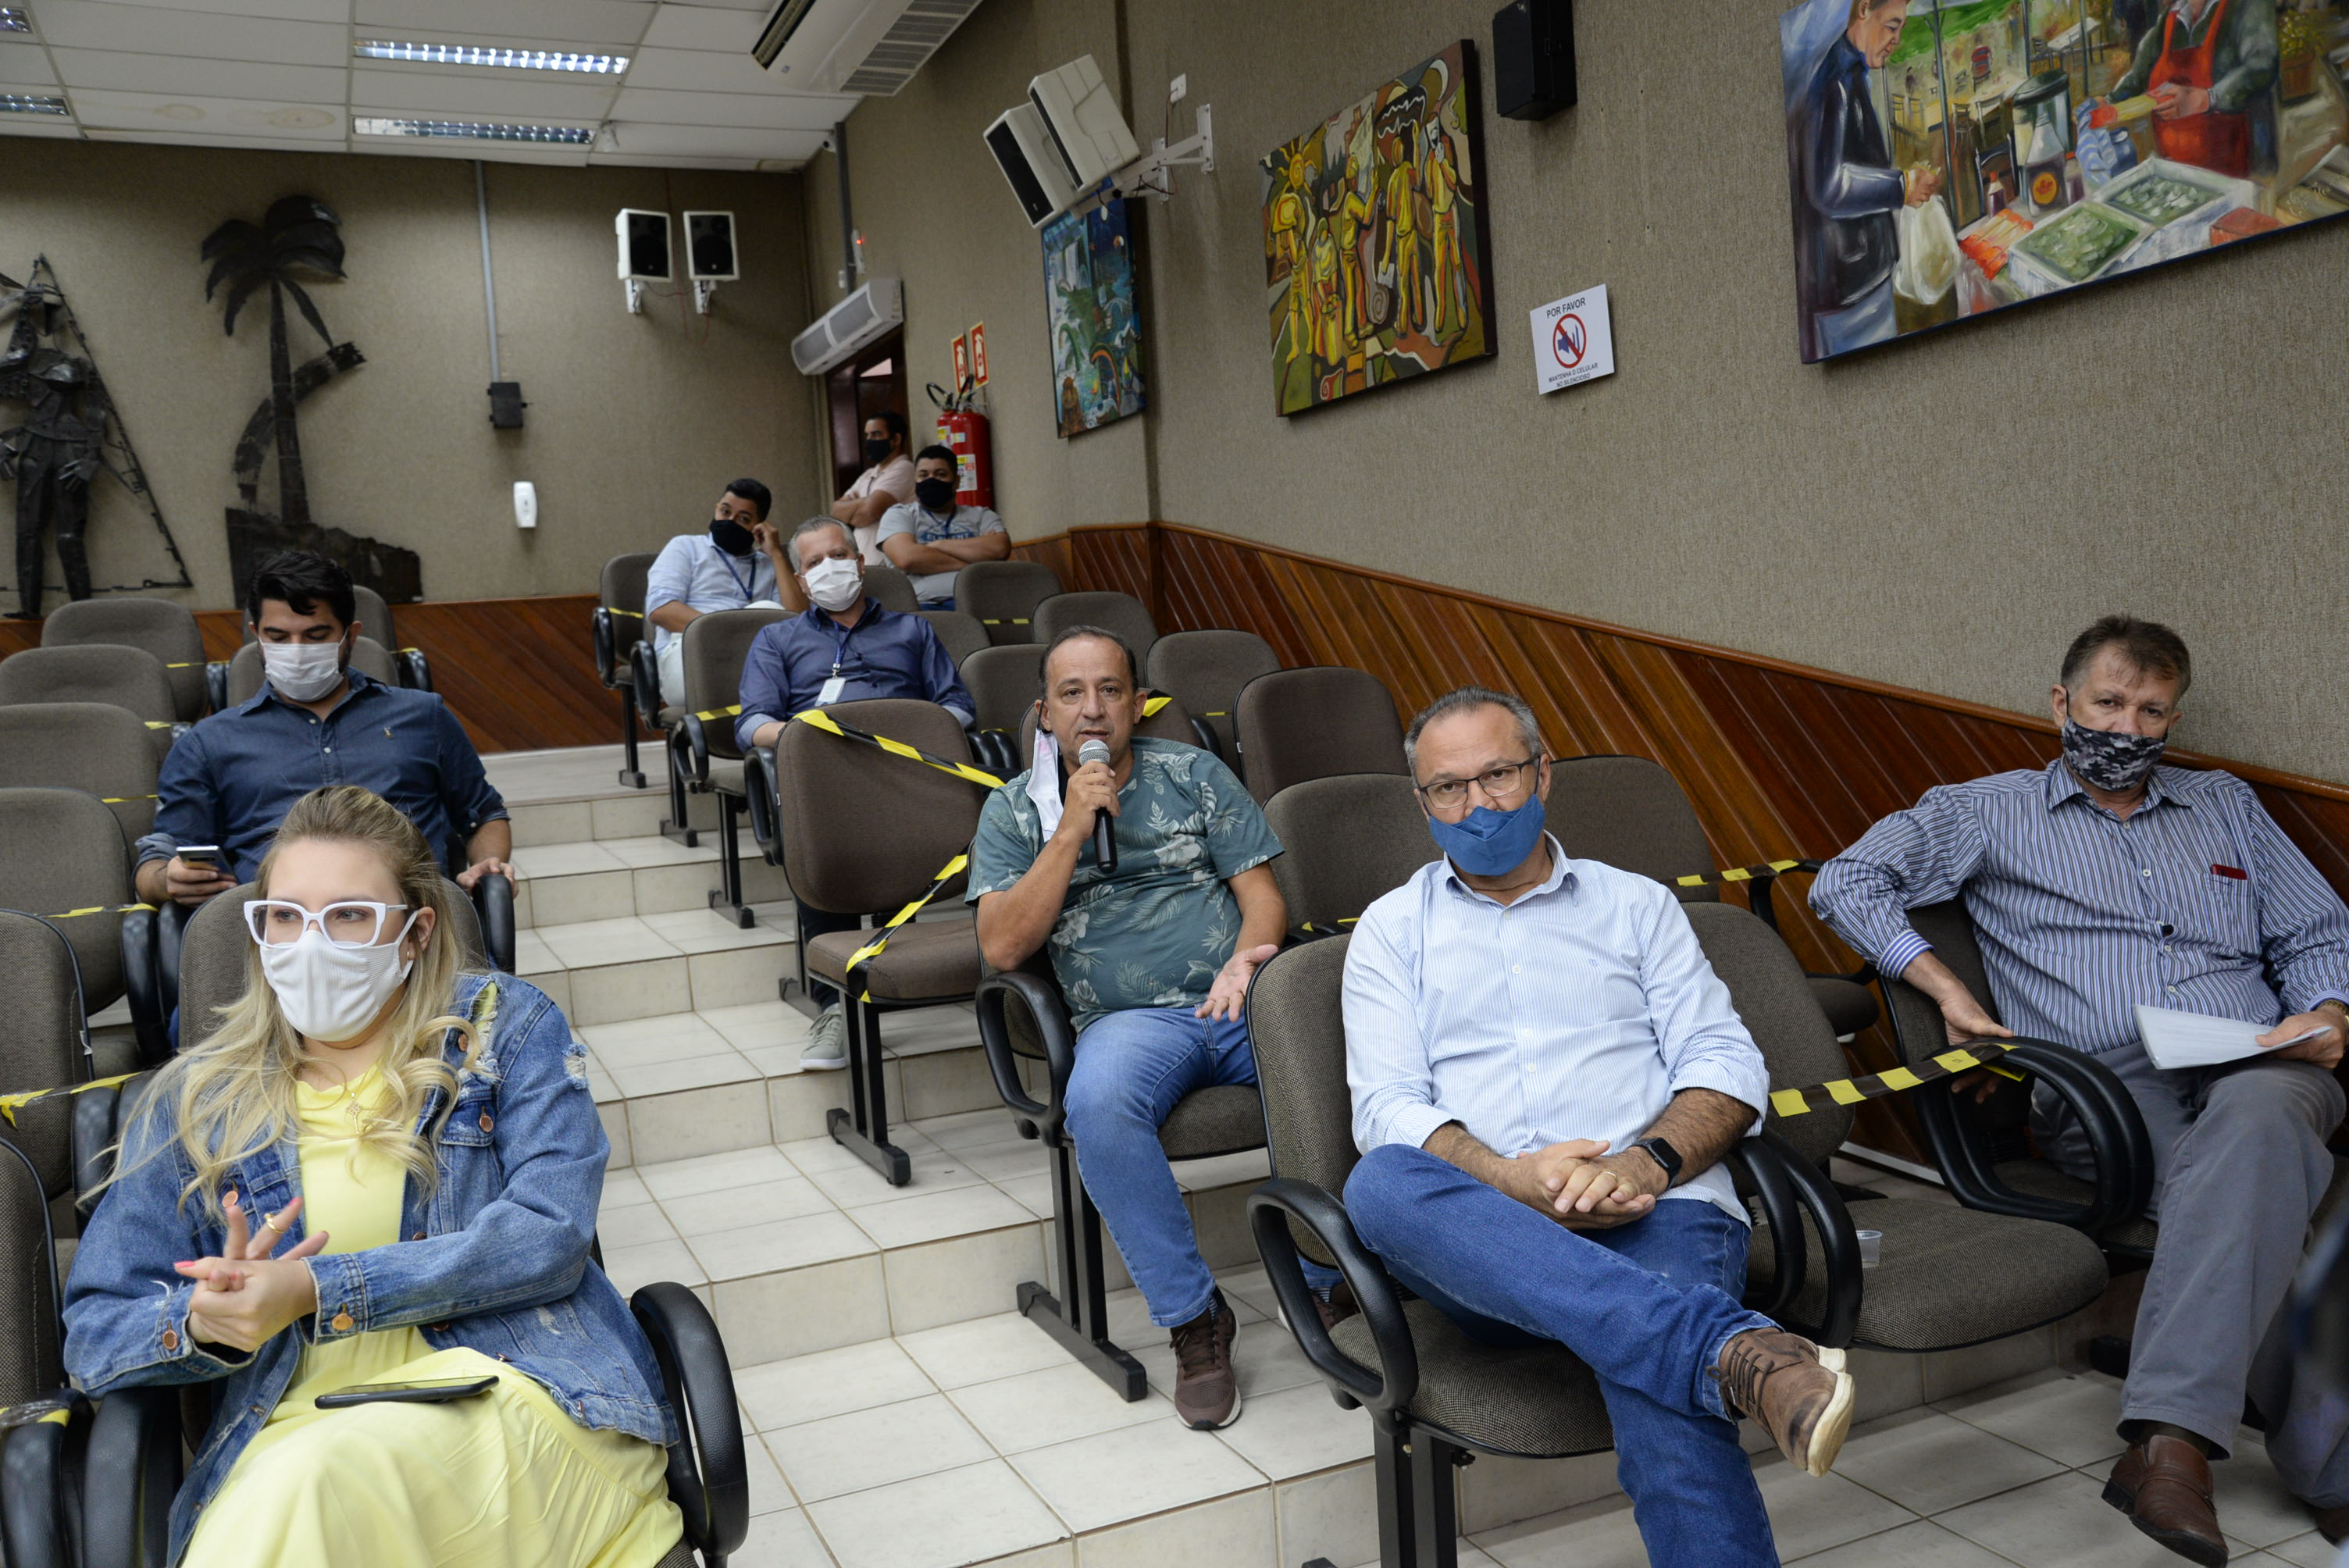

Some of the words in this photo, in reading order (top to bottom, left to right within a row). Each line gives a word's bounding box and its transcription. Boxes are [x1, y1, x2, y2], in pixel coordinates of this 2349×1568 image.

[1546, 306, 1562, 319] POR
[1563, 298, 1586, 313] FAVOR
[1549, 370, 1571, 383] MANTENHA
[1577, 362, 1599, 374] CELULAR
[1564, 372, 1591, 385] SILENCIOSO
